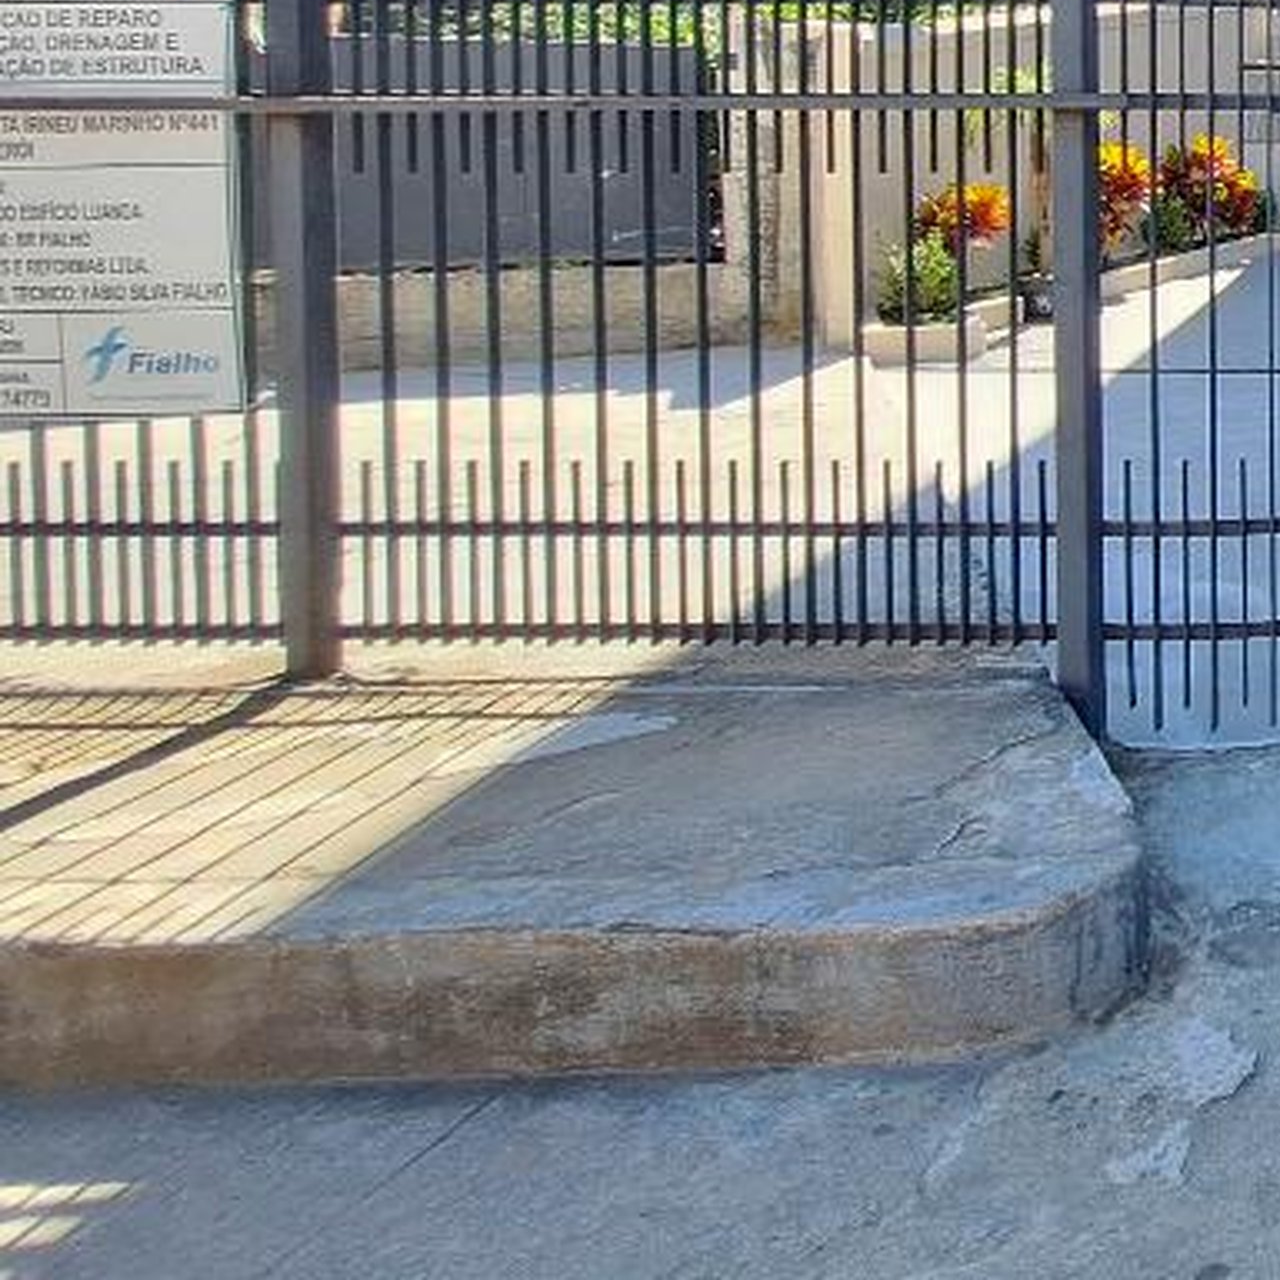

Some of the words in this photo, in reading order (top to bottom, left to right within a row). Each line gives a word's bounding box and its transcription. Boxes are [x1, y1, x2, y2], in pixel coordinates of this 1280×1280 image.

[46, 9, 72, 28] DE
[79, 9, 161, 28] REPARO
[46, 32, 159, 52] DRENAGEM
[166, 32, 180, 51] E
[0, 56, 45, 79] ÇÃO
[50, 58, 76, 75] DE
[82, 56, 207, 74] ESTRUTURA
[23, 115, 78, 133] IRINEU
[82, 114, 164, 133] MARINHO
[128, 352, 219, 374] Fialho
